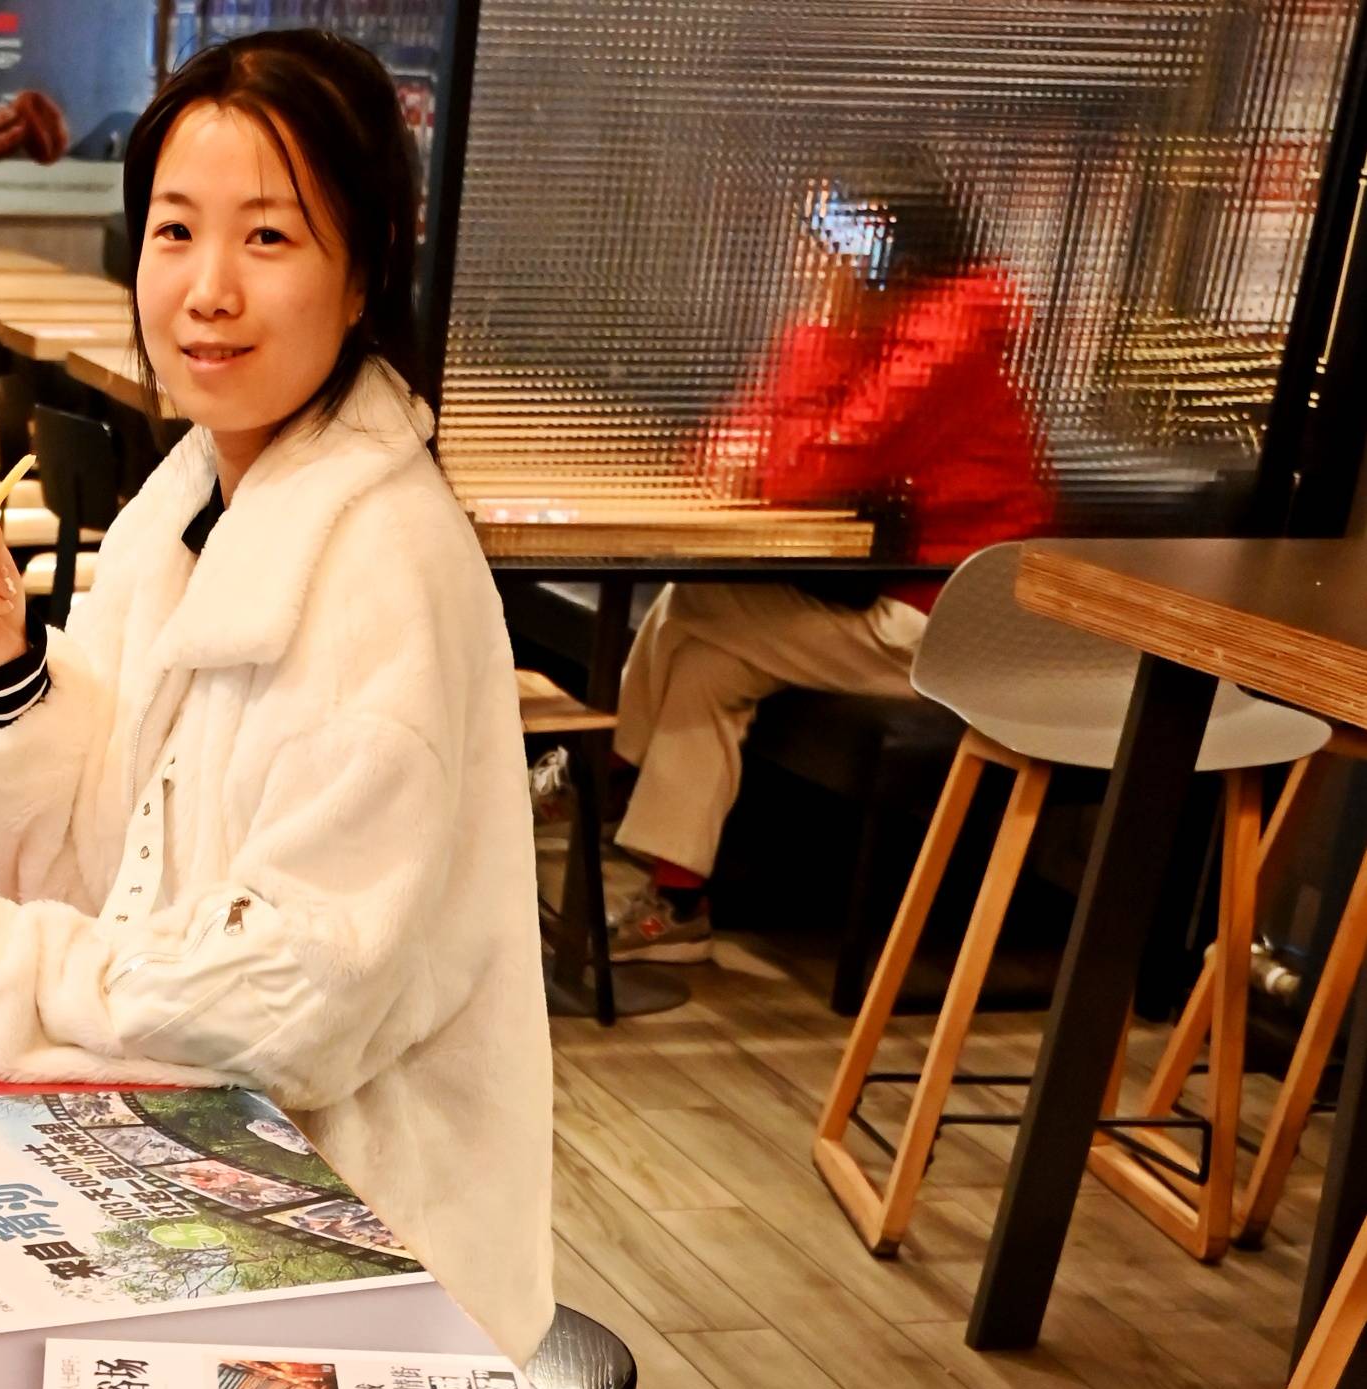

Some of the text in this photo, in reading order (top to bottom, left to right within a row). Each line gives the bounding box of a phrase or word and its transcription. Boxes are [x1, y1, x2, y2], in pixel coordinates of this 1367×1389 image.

[23, 1141, 144, 1221] 103天600壮士
[38, 1122, 196, 1221] 扛起一座山的希望
